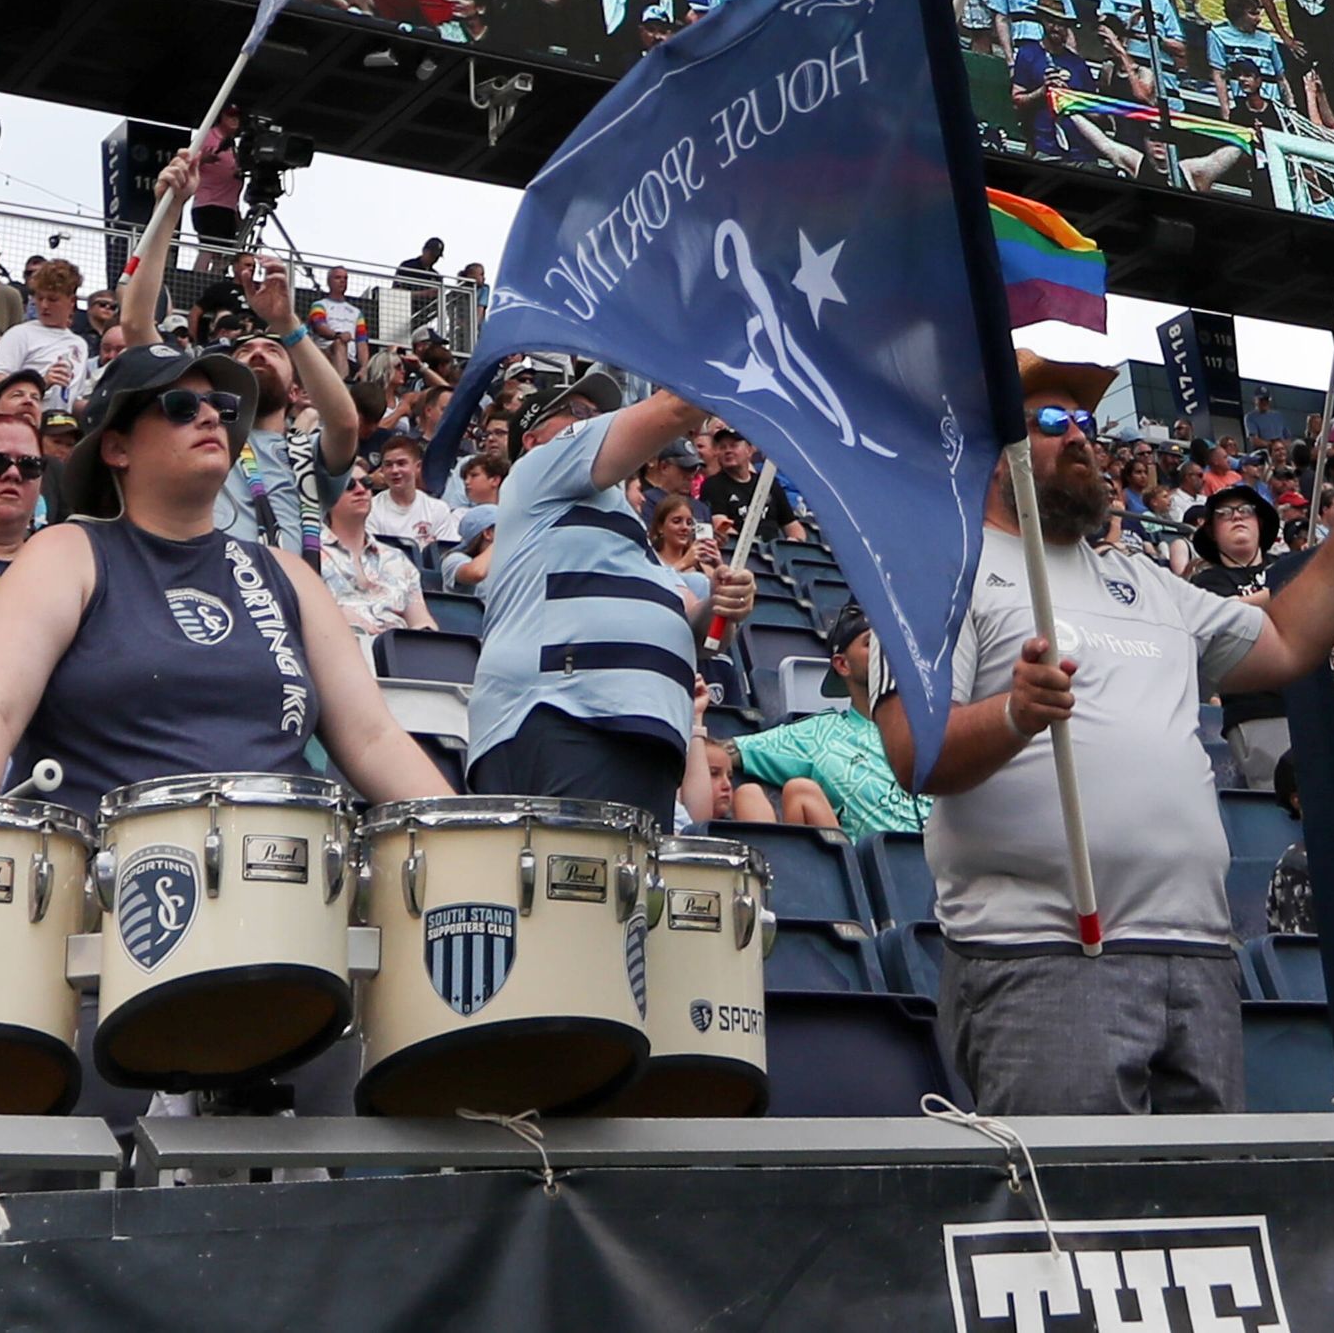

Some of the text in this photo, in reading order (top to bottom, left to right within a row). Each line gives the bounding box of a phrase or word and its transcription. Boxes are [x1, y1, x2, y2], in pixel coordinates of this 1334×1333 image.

[517, 403, 542, 431] SKC
[225, 540, 308, 737] SPORTING KC
[257, 841, 298, 863] Pearl
[120, 858, 192, 888] SPORTING
[564, 862, 598, 884] Pearl
[681, 896, 712, 915] Pearl
[427, 906, 512, 928] SOUTH STAND
[427, 921, 513, 942] SUPPORTERS CLUB
